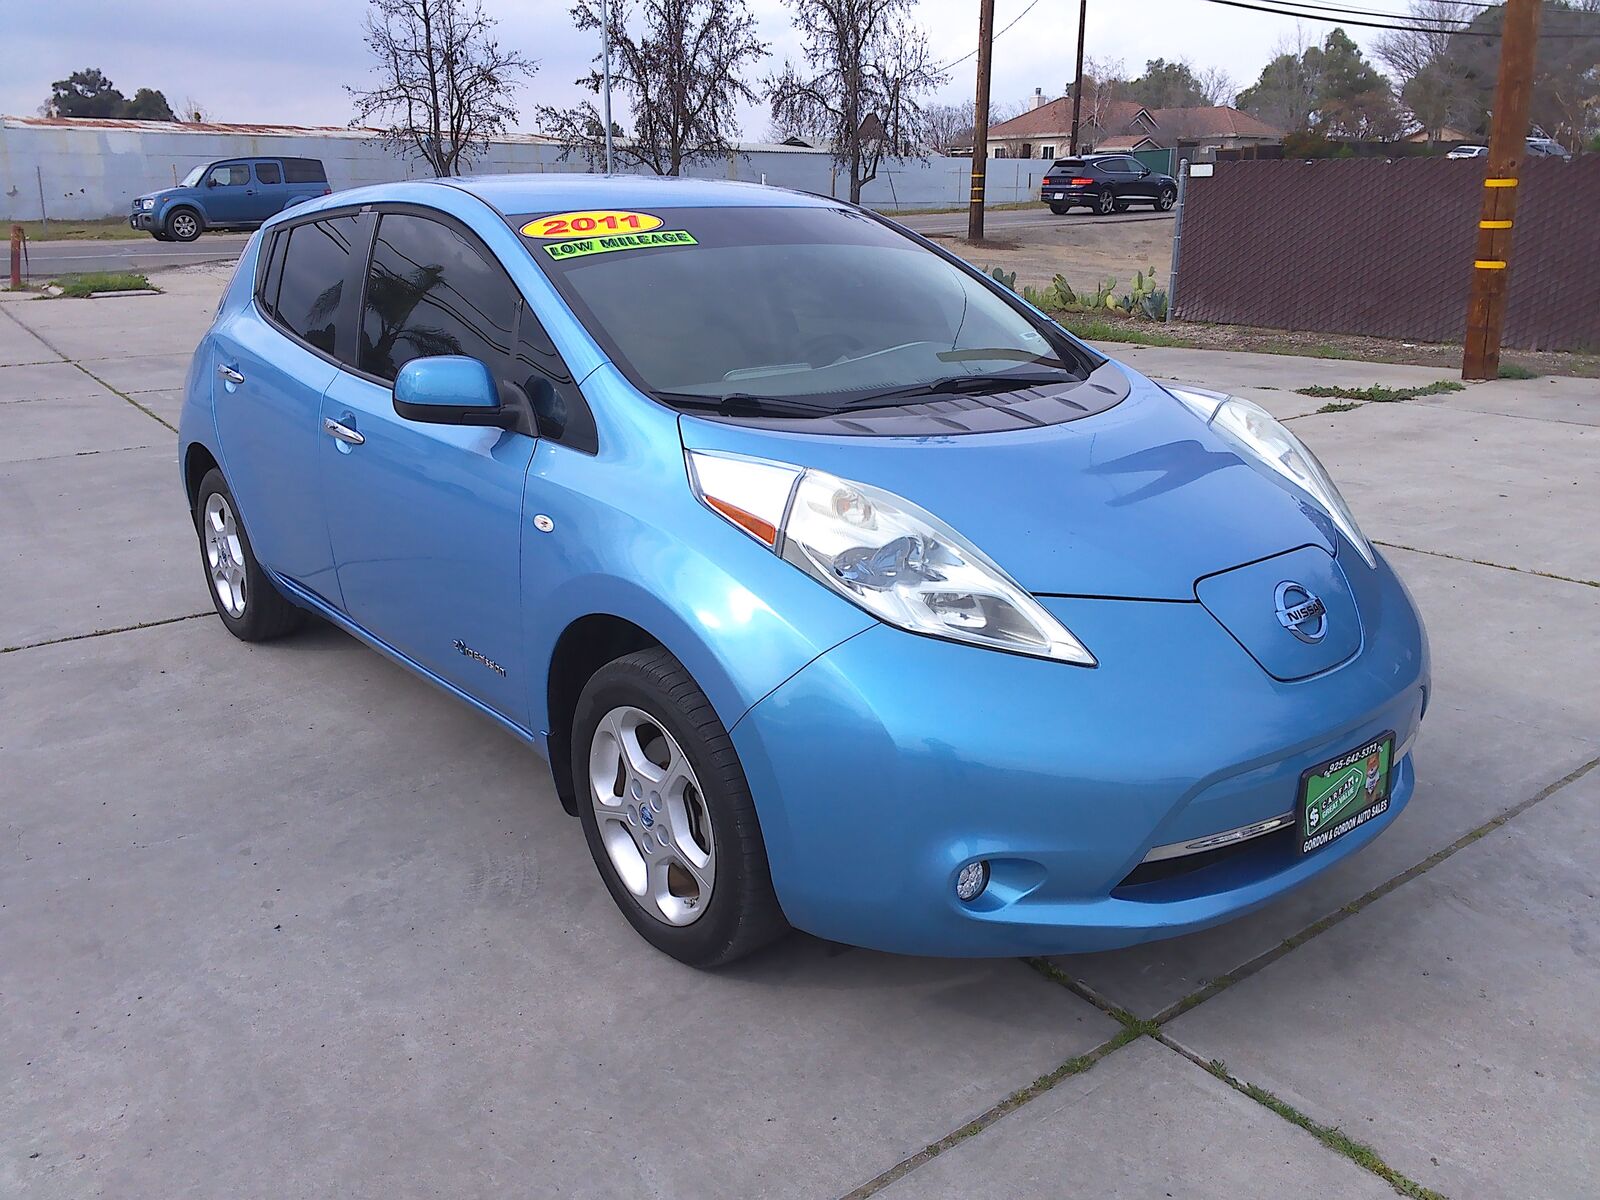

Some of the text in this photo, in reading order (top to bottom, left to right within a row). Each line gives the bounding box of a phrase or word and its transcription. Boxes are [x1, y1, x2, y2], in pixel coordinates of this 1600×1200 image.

[543, 215, 641, 236] 2011
[549, 232, 690, 256] LOW MILEAGE
[1287, 602, 1321, 621] NISSAN
[1303, 832, 1329, 853] GORDON
[1333, 816, 1357, 837] GORDON
[1357, 808, 1371, 825] AUTO
[1371, 799, 1388, 816] SALES
